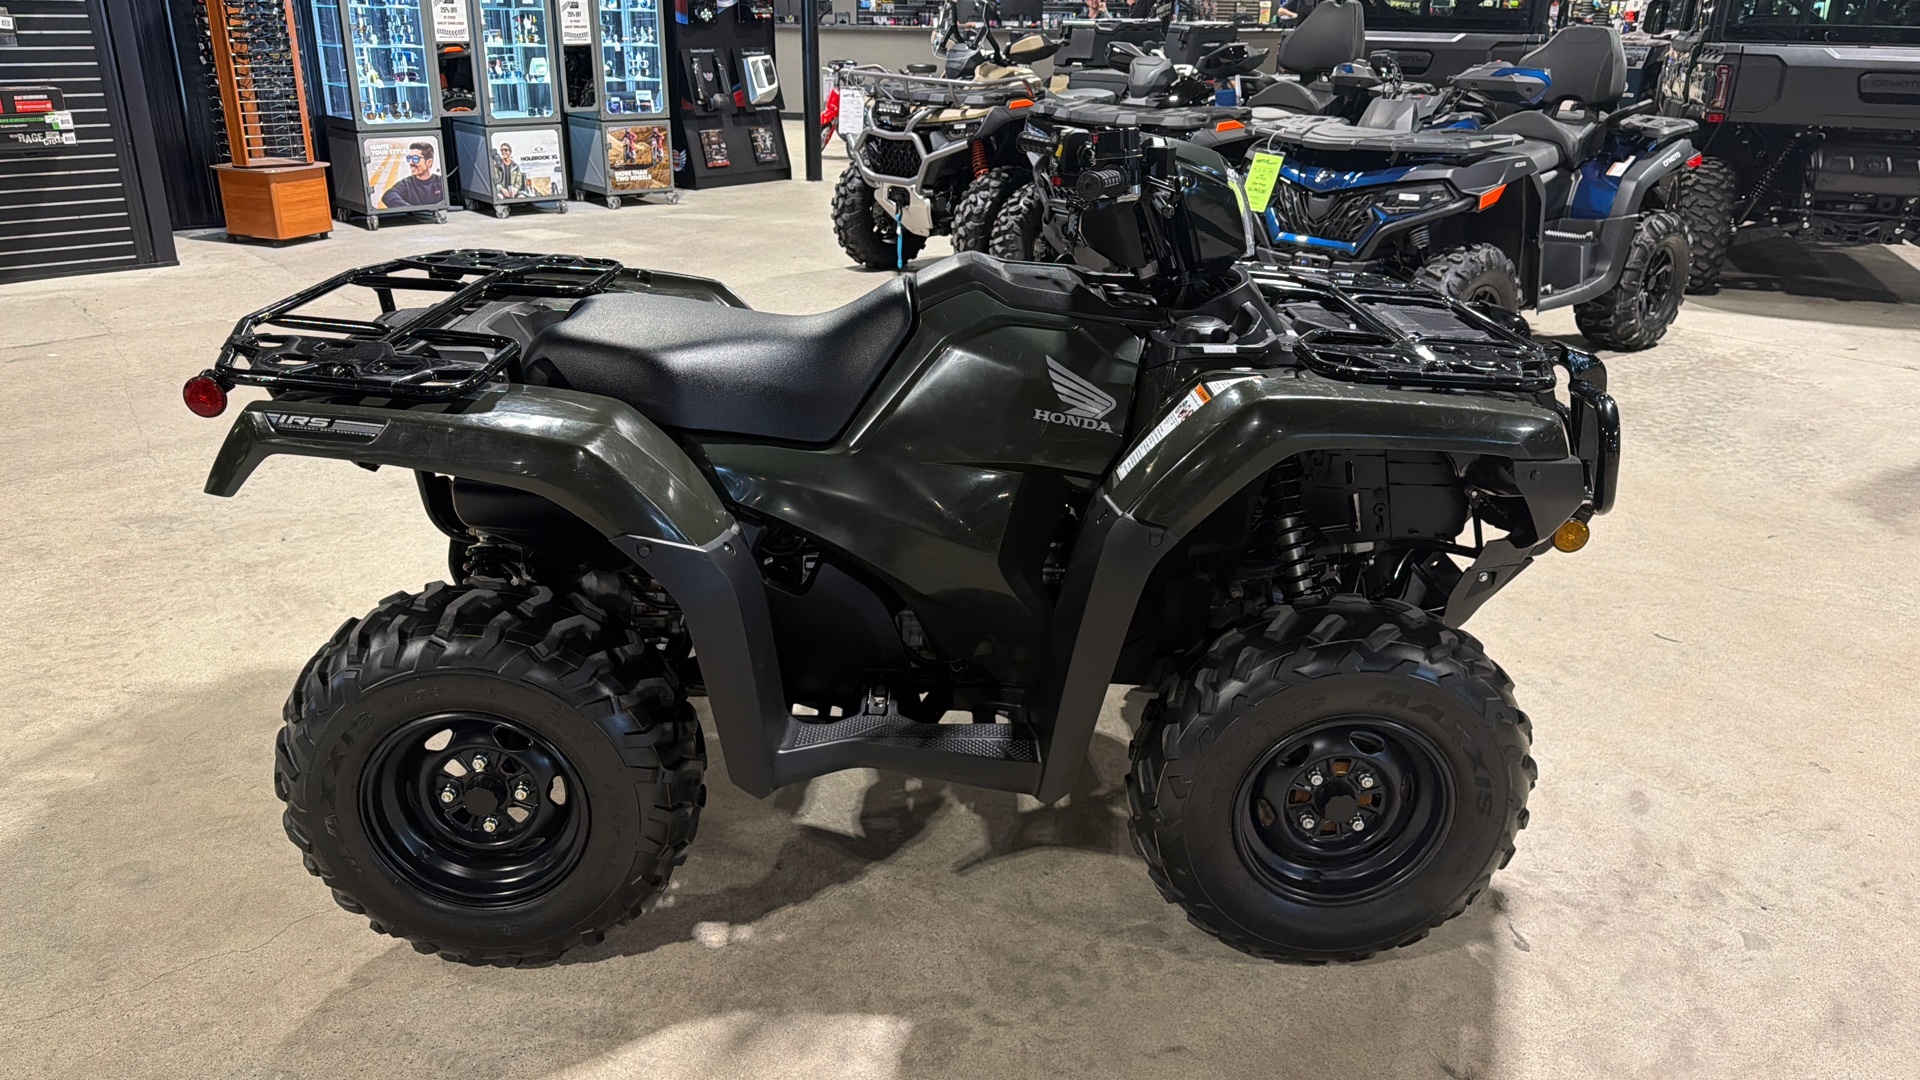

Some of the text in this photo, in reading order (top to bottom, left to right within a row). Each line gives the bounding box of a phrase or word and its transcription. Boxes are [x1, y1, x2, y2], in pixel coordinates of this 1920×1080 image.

[18, 133, 44, 144] RAGE
[278, 414, 331, 428] IRS
[1033, 408, 1115, 434] HONDA
